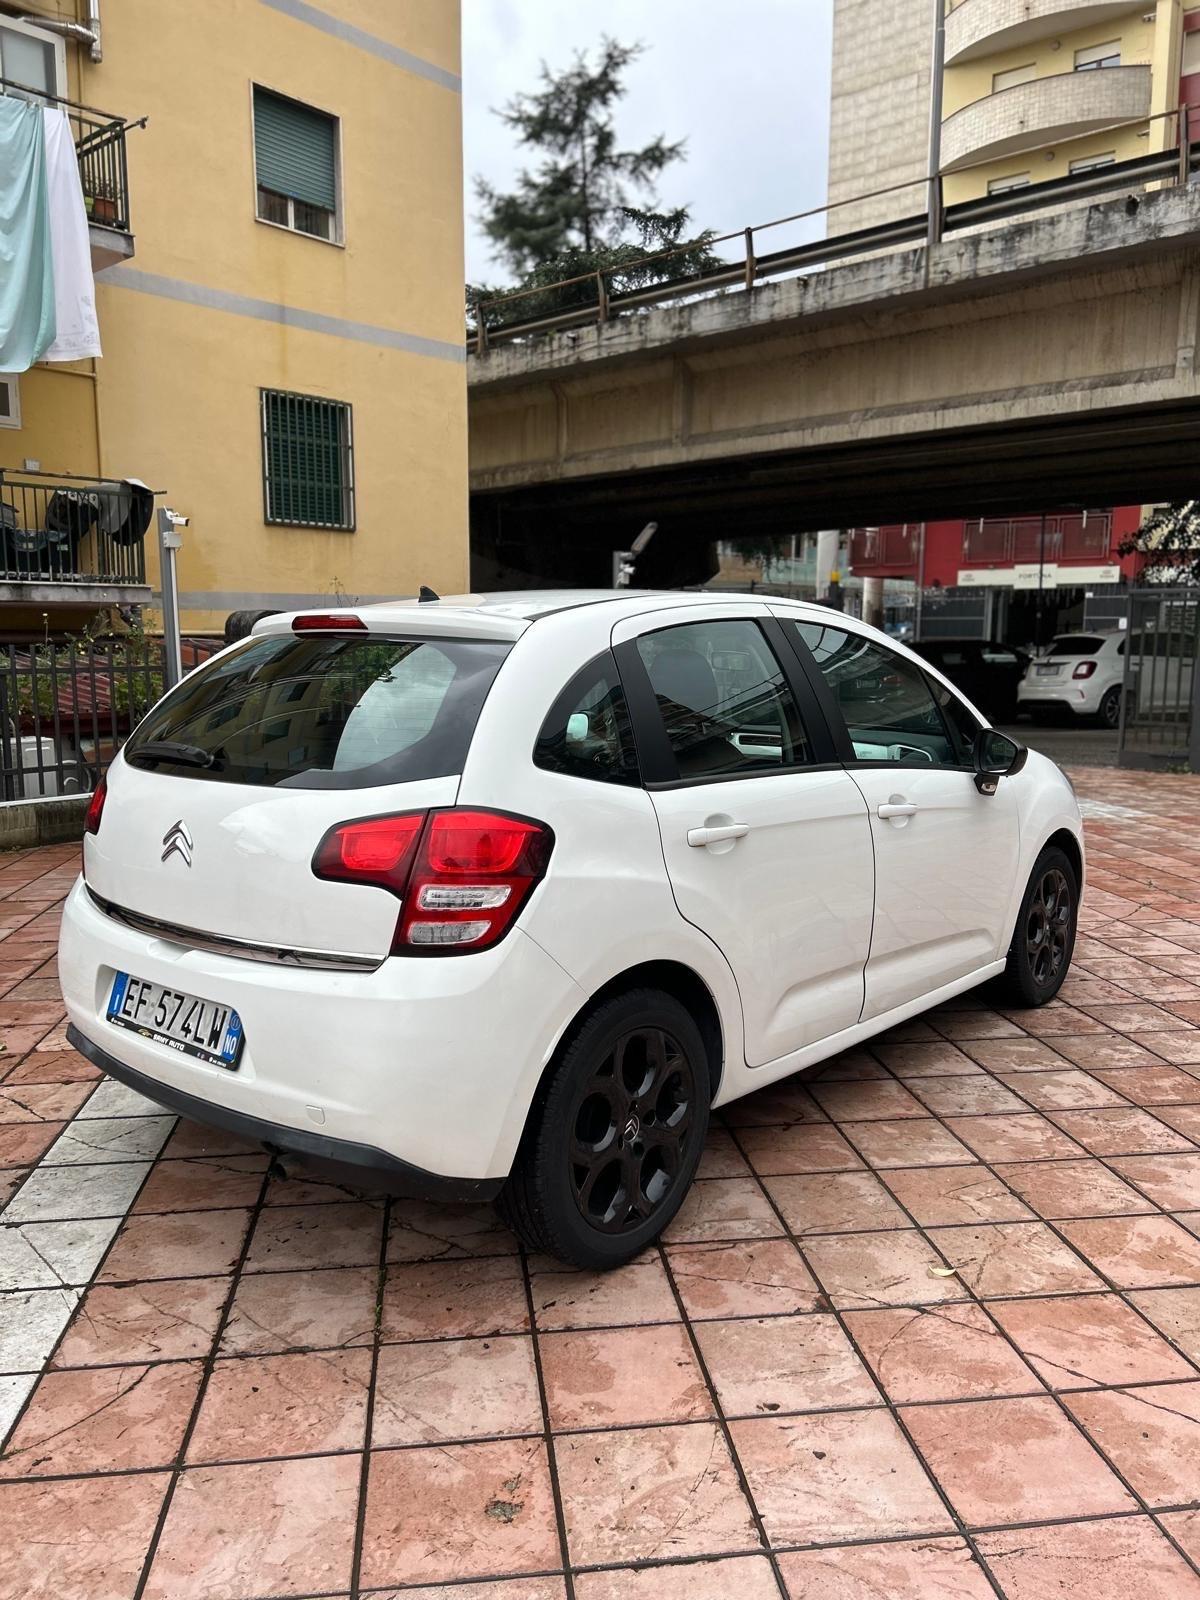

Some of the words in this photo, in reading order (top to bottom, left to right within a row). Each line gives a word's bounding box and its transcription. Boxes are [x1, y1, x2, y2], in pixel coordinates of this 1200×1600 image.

[122, 979, 152, 1018] EF
[155, 990, 227, 1049] 574LW
[169, 1040, 185, 1050] AUTO
[224, 1034, 236, 1055] NO
